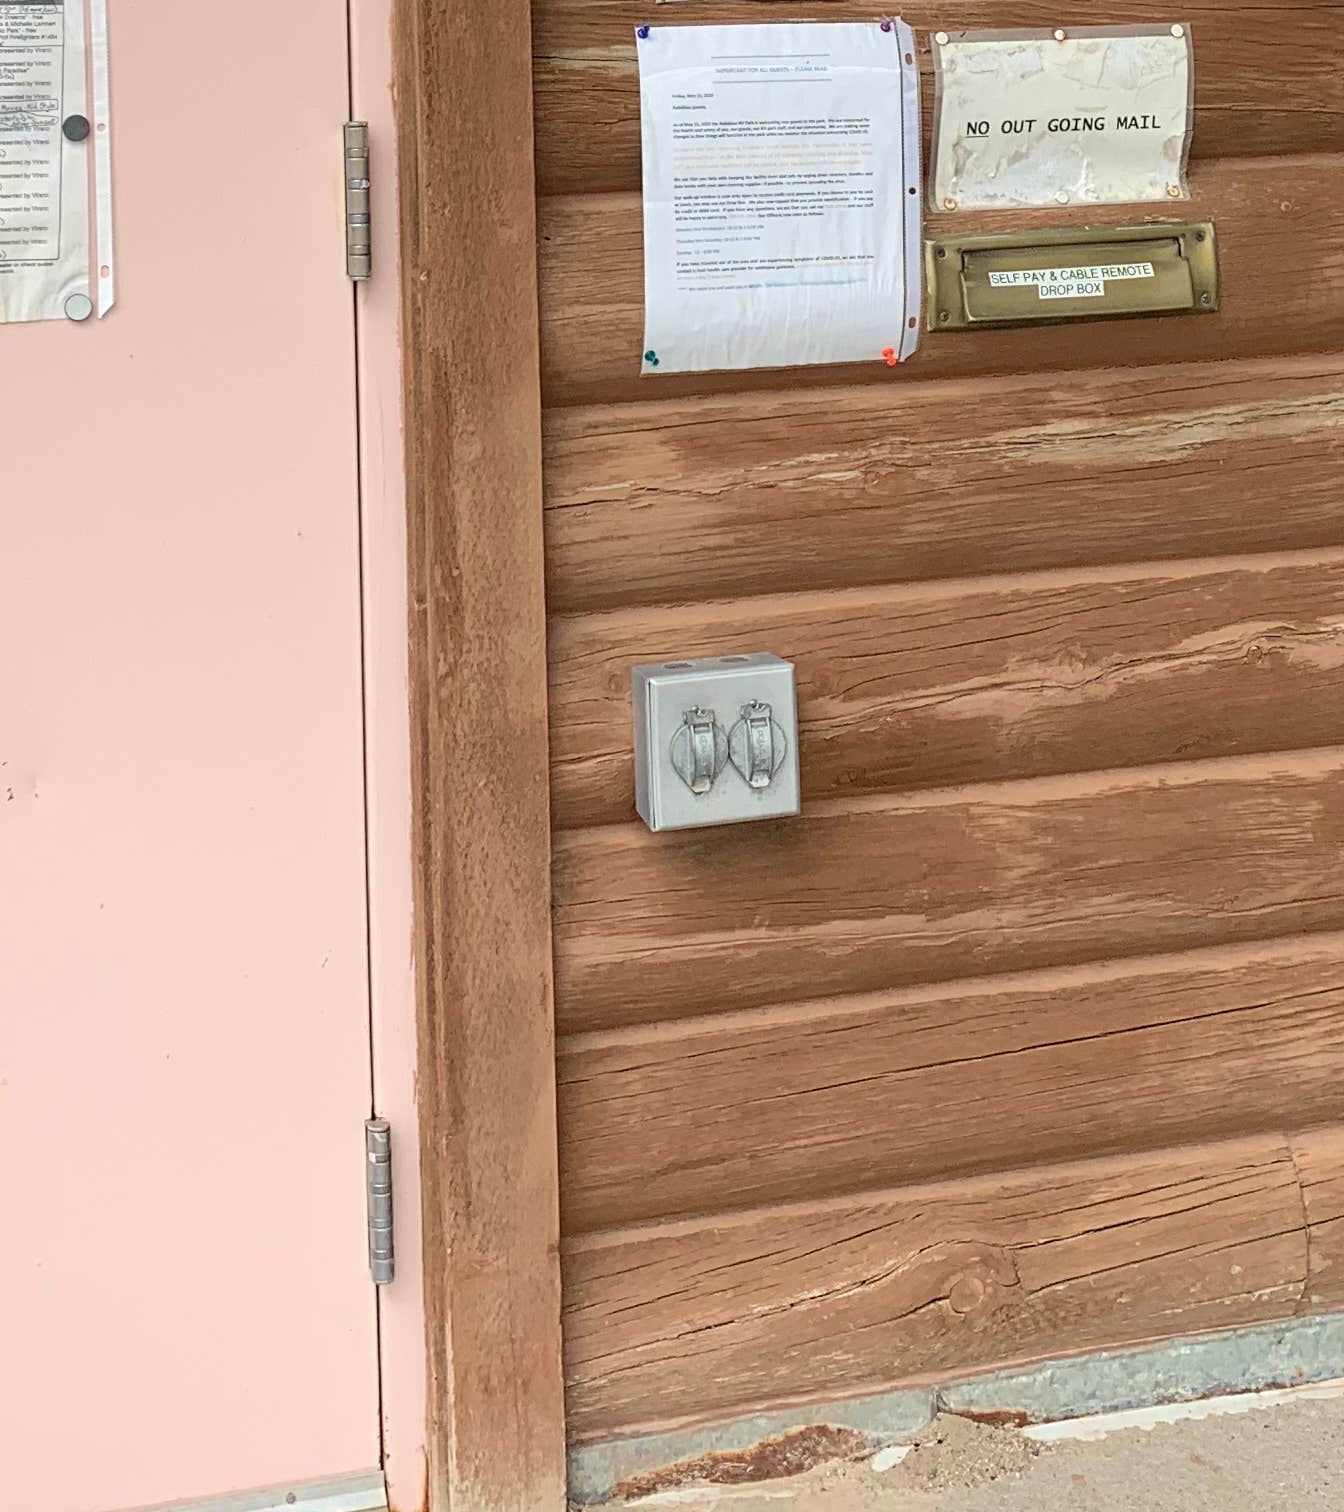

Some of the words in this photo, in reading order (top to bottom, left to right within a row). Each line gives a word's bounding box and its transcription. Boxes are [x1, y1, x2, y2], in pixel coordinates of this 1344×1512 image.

[966, 120, 990, 135] NO
[1001, 119, 1037, 134] OUT
[1047, 117, 1105, 132] GOING
[1116, 115, 1161, 130] MAIL
[991, 273, 1021, 284] SELF
[1023, 271, 1047, 283] PAY
[1050, 270, 1058, 281] &
[1060, 268, 1098, 281] CABLE
[1101, 265, 1151, 278] REMOTE
[1040, 284, 1074, 296] DROP
[1077, 283, 1102, 295] BOX
